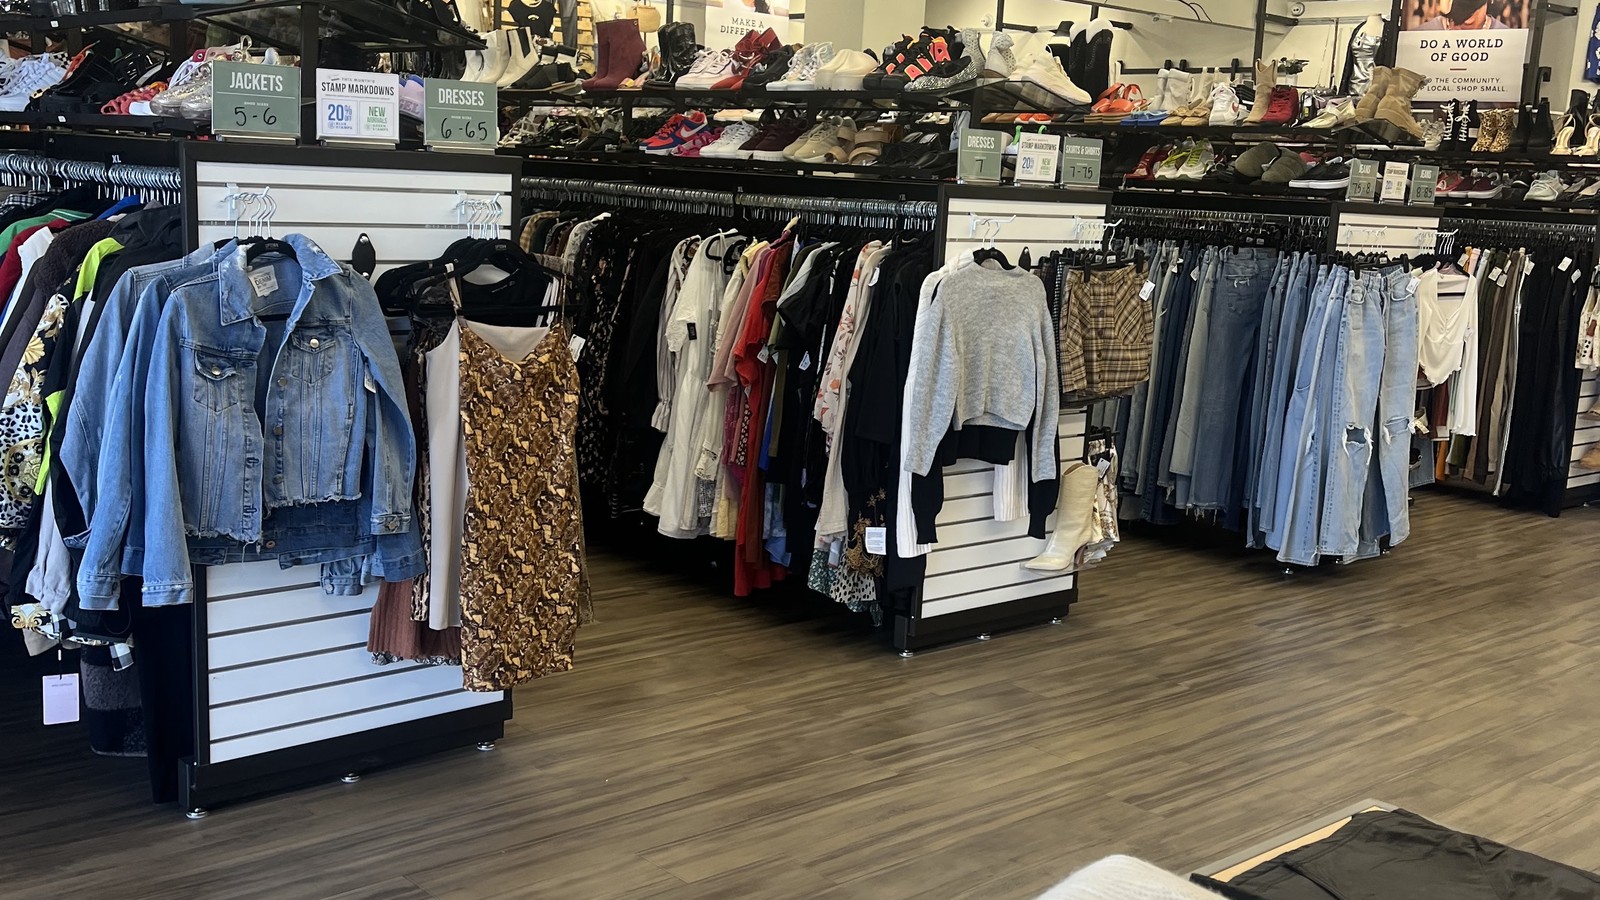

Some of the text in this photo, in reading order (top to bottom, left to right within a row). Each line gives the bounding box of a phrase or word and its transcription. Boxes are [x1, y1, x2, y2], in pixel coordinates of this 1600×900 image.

[732, 17, 756, 27] MAKE
[1420, 39, 1503, 48] DO A WORLD
[1430, 52, 1489, 61] OF GOOD
[229, 72, 283, 92] JACKETS
[321, 82, 394, 95] STAMP MARKDOWNS
[438, 88, 484, 106] DRESSES
[368, 106, 385, 117] NEW
[967, 135, 995, 149] DRESSES
[111, 155, 121, 163] XL
[975, 159, 984, 173] 7
